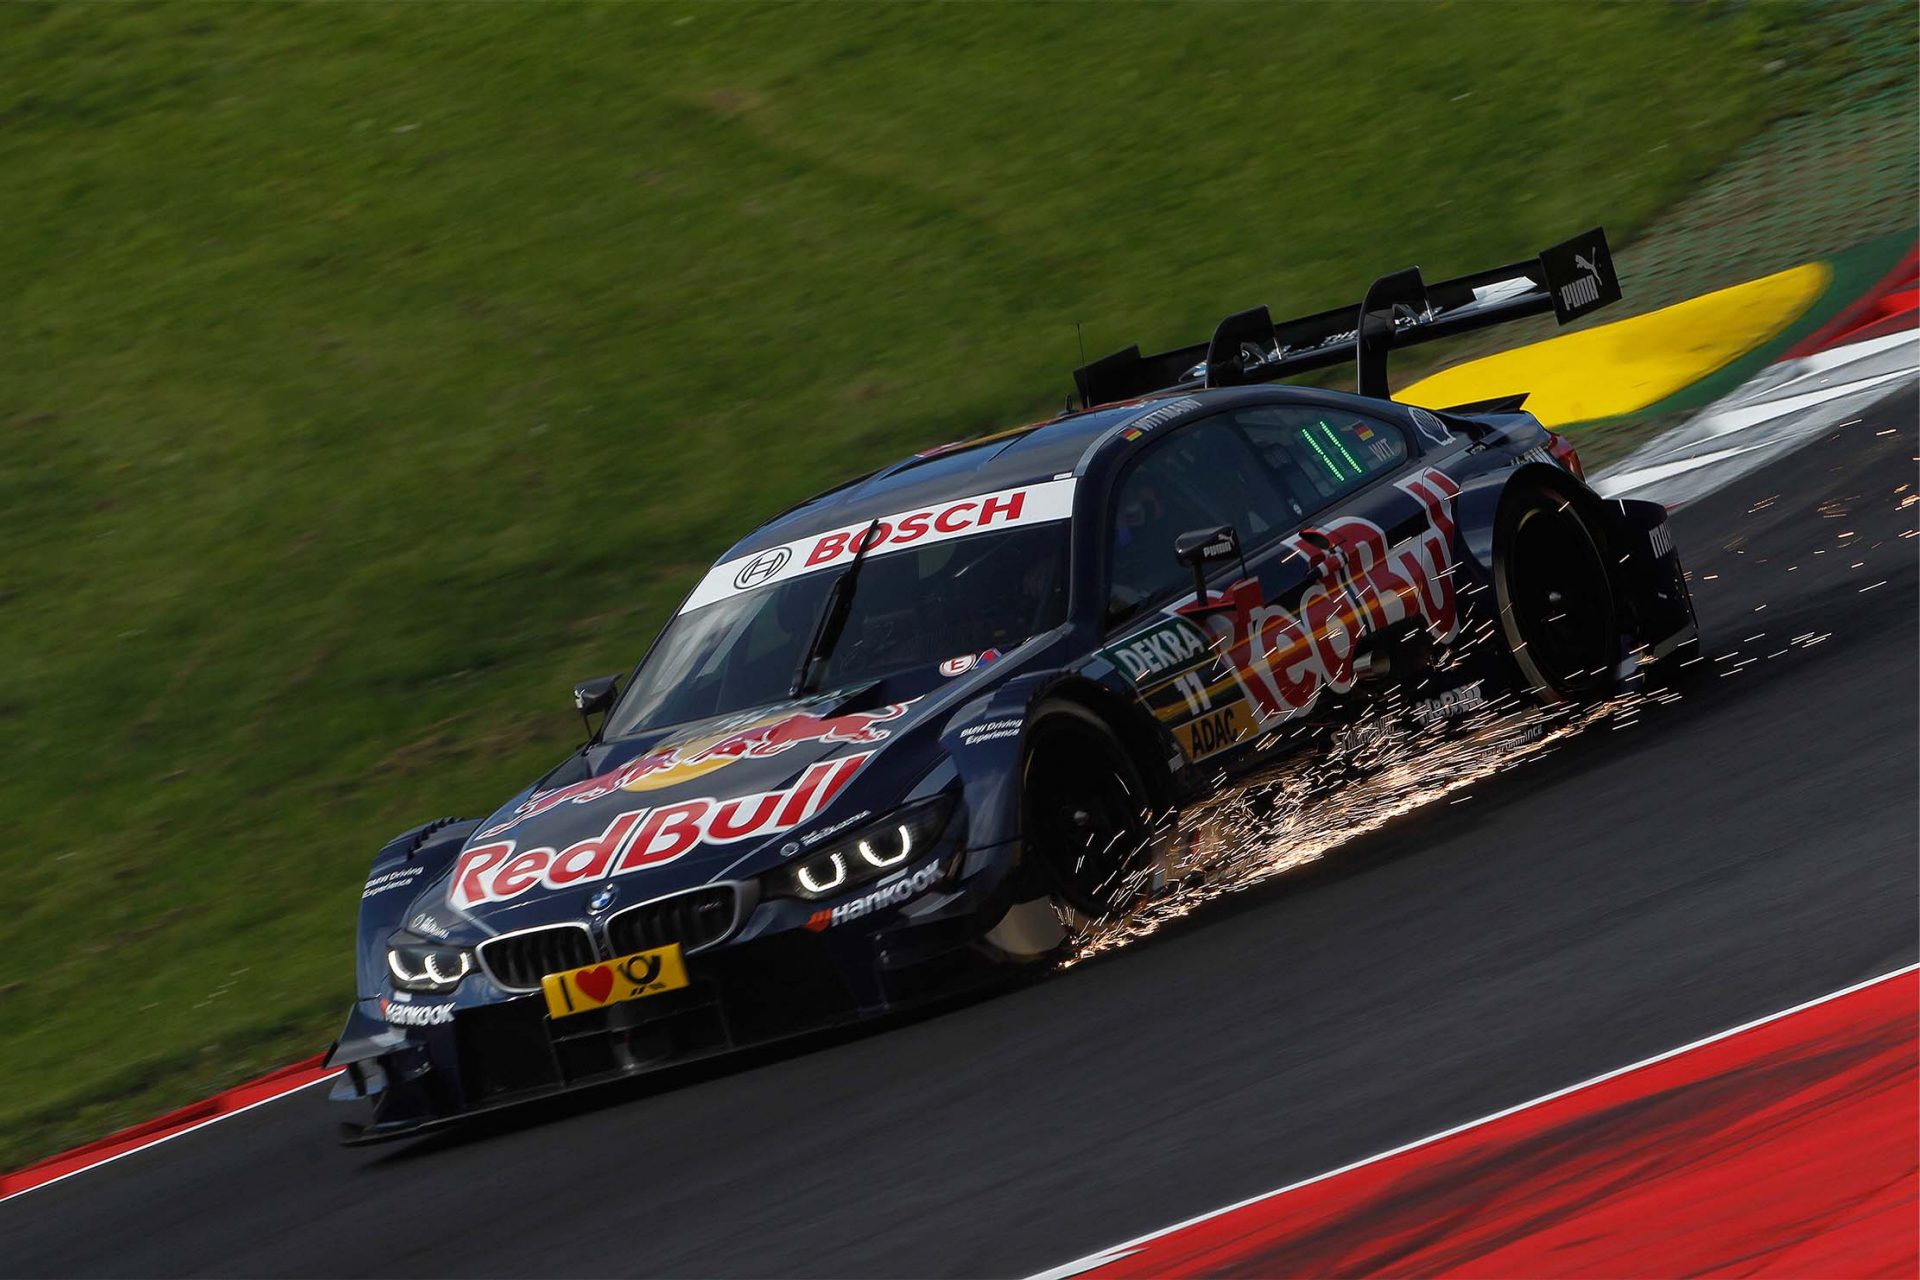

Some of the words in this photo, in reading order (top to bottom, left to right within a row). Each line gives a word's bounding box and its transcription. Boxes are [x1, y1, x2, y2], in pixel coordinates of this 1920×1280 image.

[1561, 275, 1599, 311] PUMA
[1132, 399, 1203, 431] WITTMANN
[1302, 421, 1363, 481] 11
[1368, 438, 1395, 462] WIT
[803, 491, 1026, 567] BOSCH
[1203, 541, 1232, 558] PUMA
[1115, 623, 1204, 677] DEKRA
[1174, 671, 1212, 716] 11
[960, 723, 987, 738] BMW
[987, 719, 1023, 732] Driving
[965, 729, 1020, 745] Experience
[1190, 708, 1238, 758] ADAC
[362, 878, 413, 899] Experience
[389, 866, 424, 882] Driving
